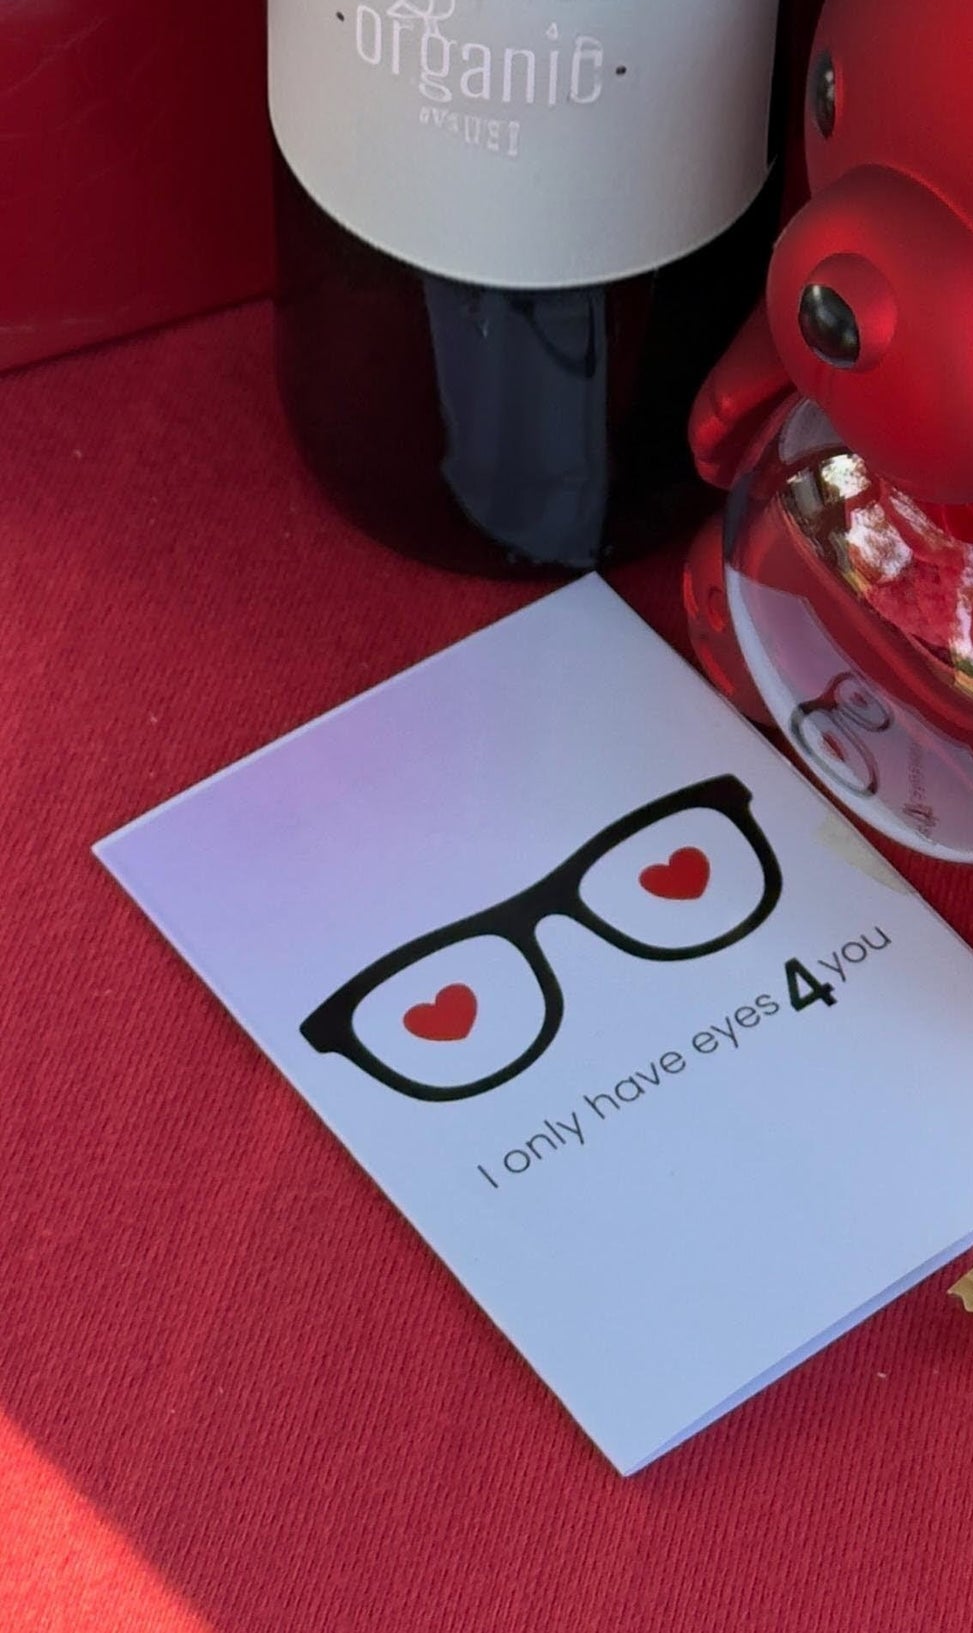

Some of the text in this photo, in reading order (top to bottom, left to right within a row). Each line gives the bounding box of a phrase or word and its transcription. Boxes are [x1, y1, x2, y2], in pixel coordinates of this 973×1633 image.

[477, 925, 892, 1189] I only have eyes 4 you
